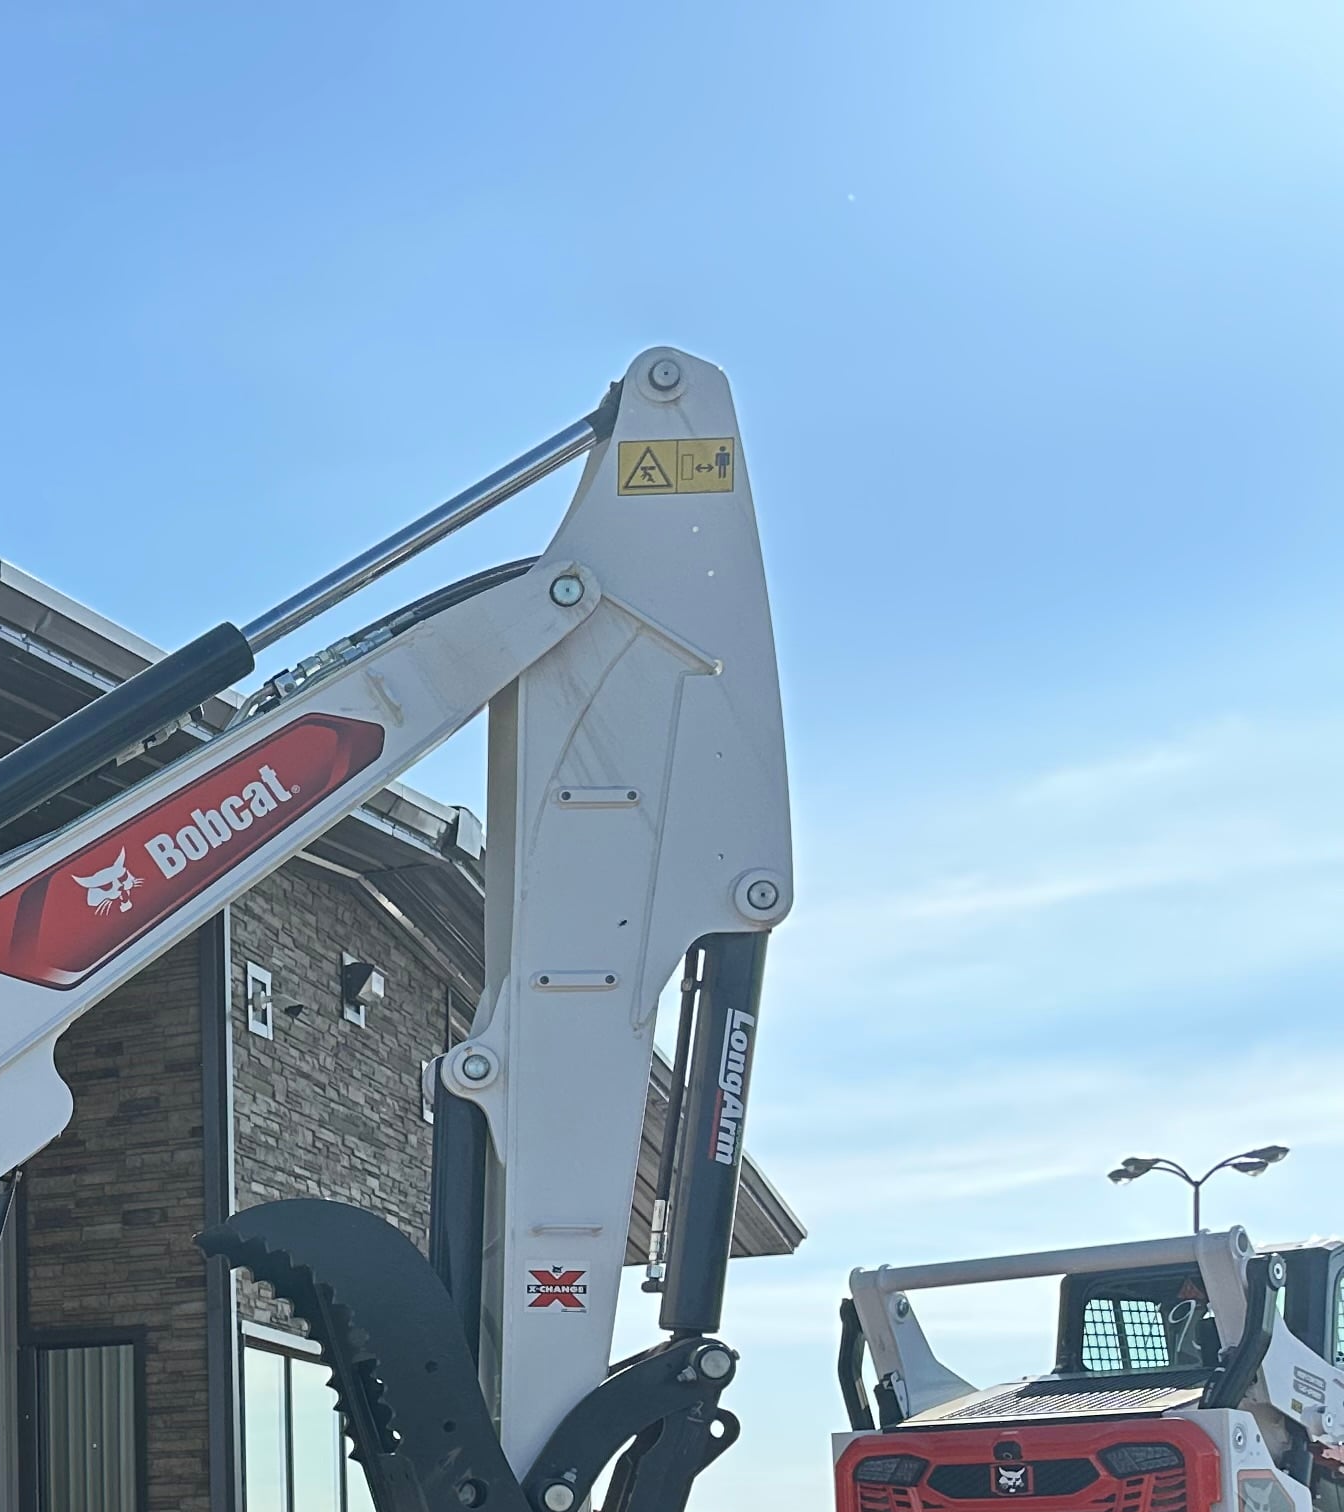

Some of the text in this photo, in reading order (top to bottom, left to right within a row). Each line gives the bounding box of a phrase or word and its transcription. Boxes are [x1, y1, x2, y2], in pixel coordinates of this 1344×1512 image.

[144, 764, 294, 879] Bobcat
[715, 1008, 755, 1166] LongArm
[529, 1285, 584, 1293] X-CHANGE
